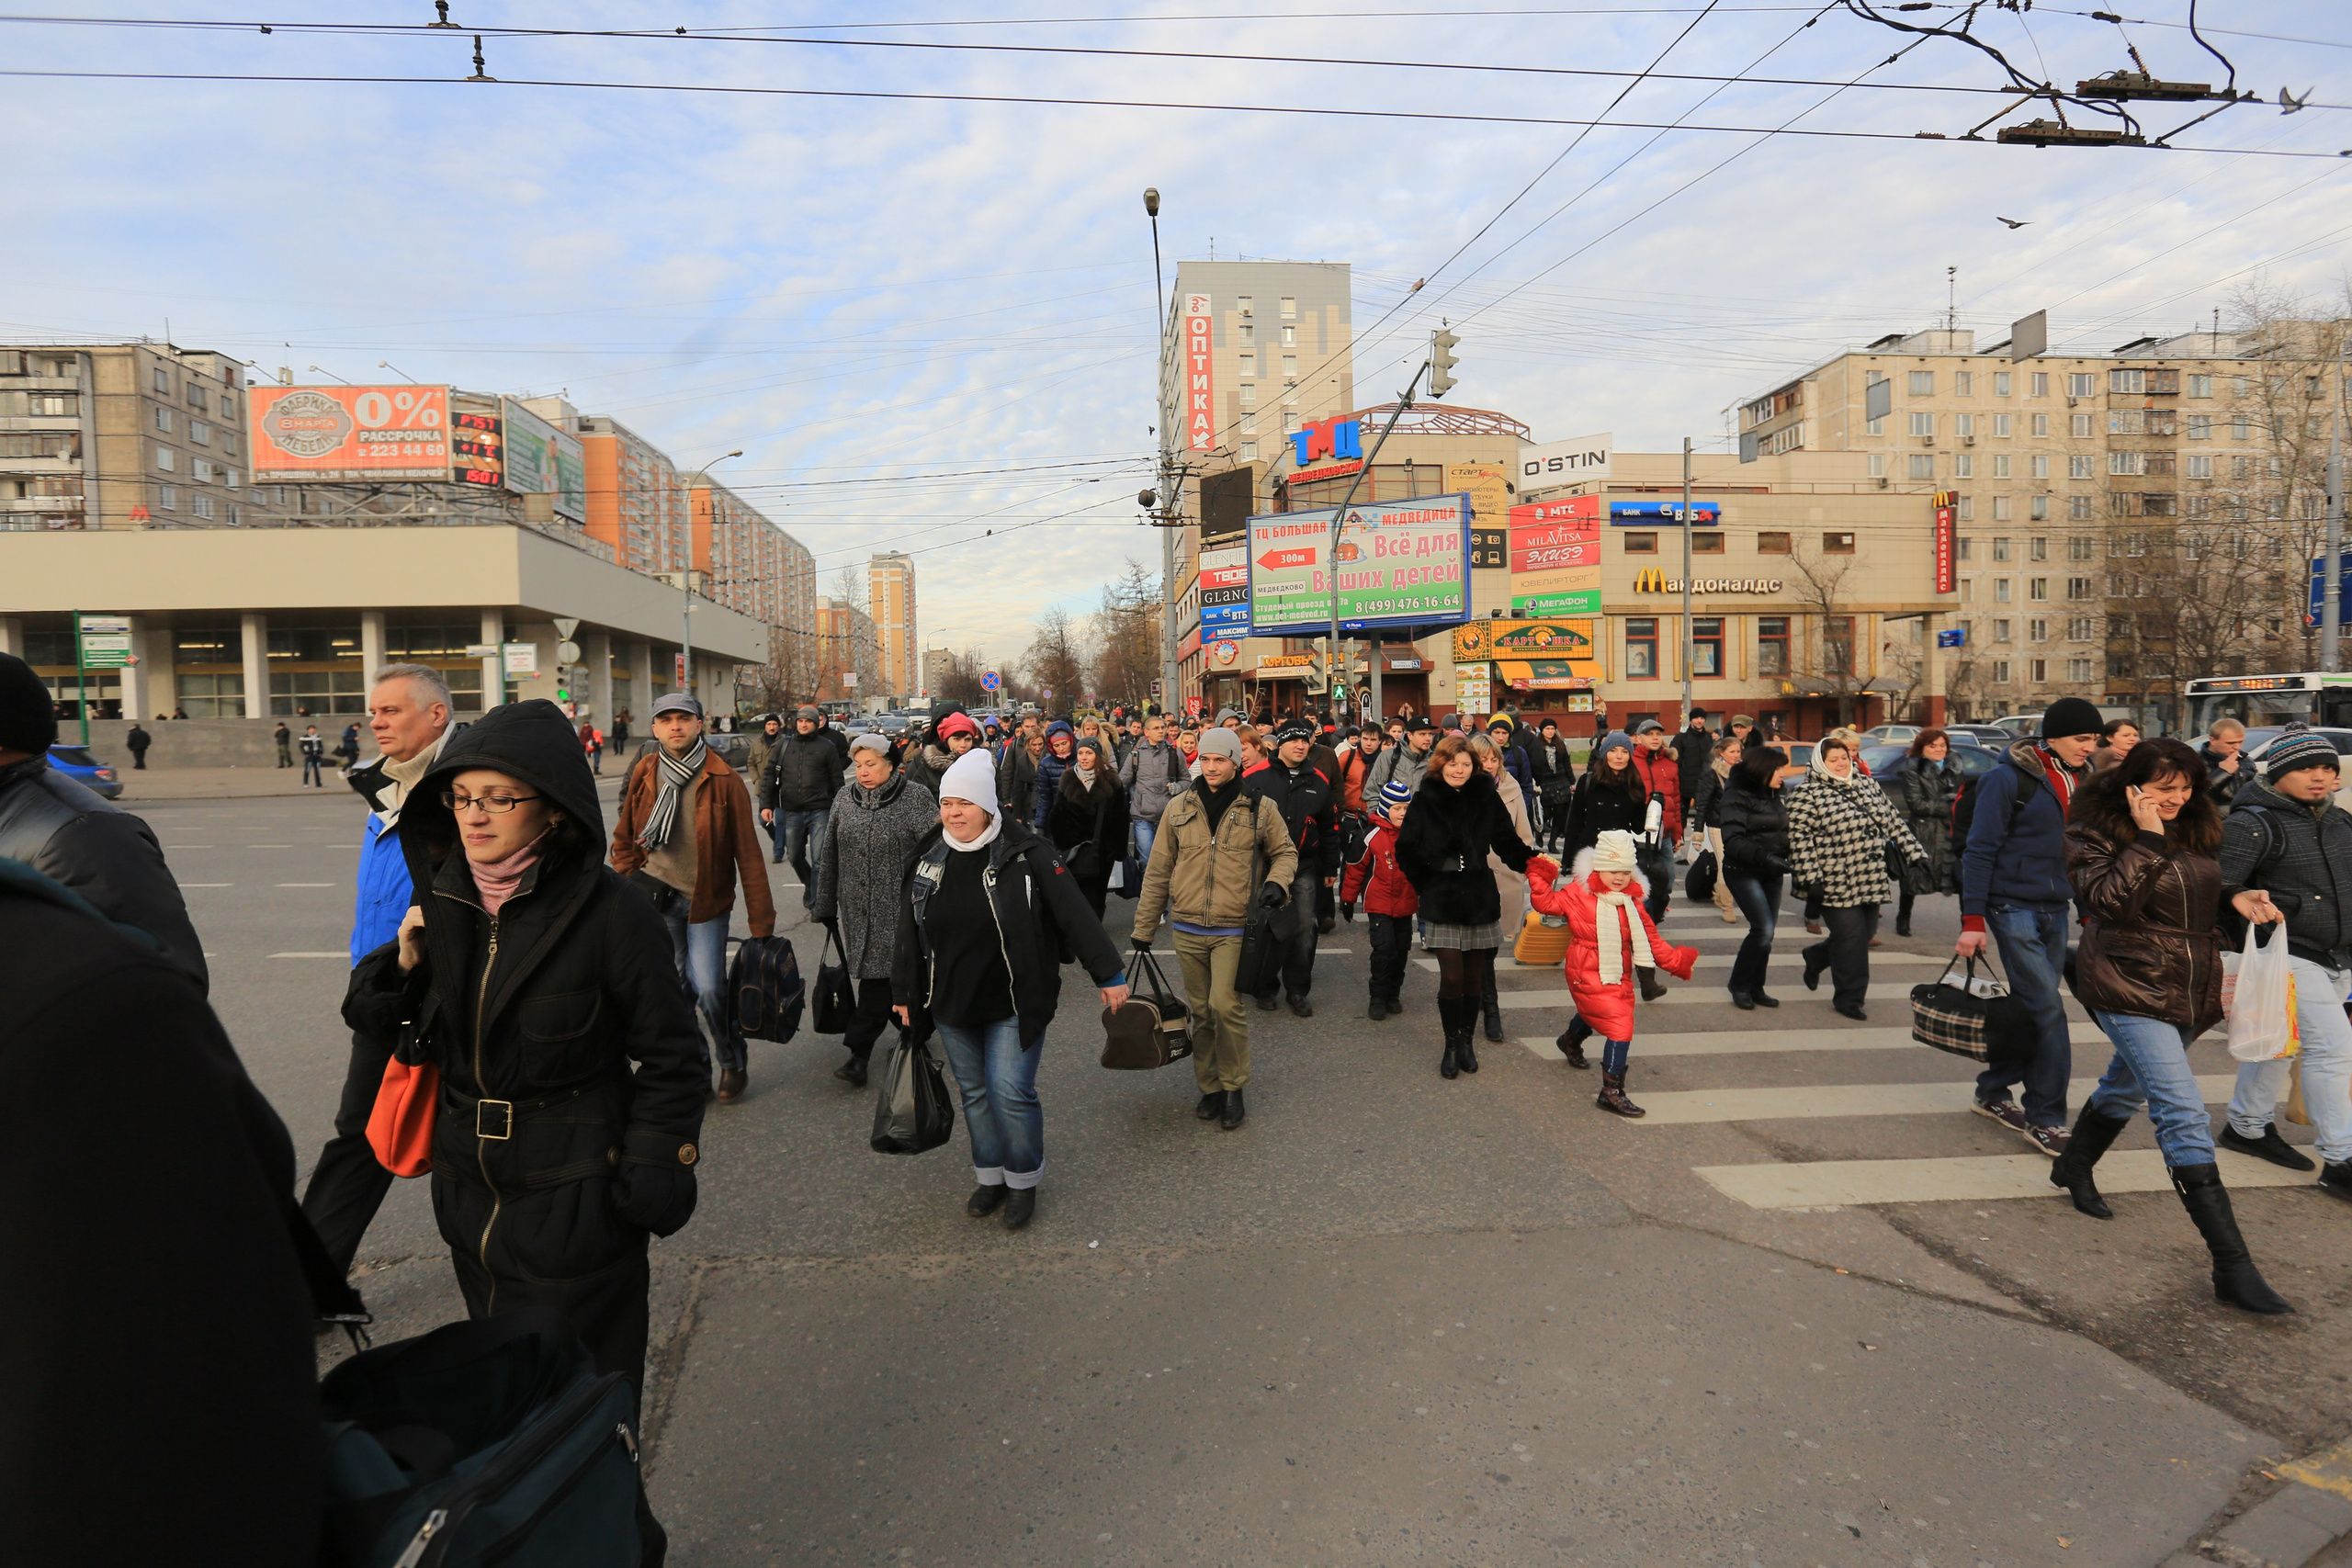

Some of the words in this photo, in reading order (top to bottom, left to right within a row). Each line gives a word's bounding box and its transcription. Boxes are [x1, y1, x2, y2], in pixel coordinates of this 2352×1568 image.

[1192, 318, 1209, 430] ОПТИКА
[280, 396, 334, 416] ФАБРИКА
[282, 420, 294, 429] 8
[294, 419, 334, 428] МАРТА
[359, 430, 441, 442] РАССРОЧКА
[1289, 414, 1363, 466] ТМЦ
[282, 434, 334, 452] МЕБЕЛИ
[369, 445, 400, 457] 223
[402, 445, 423, 457] 44
[425, 445, 446, 456] 60
[1288, 459, 1364, 484] МЕДВЕДКОВСКИЙ
[1382, 507, 1456, 526] МЕДВЕДИЦА
[1550, 504, 1575, 516] МТС
[1623, 508, 1641, 516] БАНК
[1675, 509, 1713, 522] ВБ24
[1256, 528, 1270, 540] ТЦ
[1272, 521, 1327, 538] БОЛЬШАЯ
[1374, 532, 1411, 558] Всё
[1416, 534, 1459, 558] для
[1527, 530, 1581, 547] MILAVITSA
[1281, 553, 1306, 564] 300м
[1213, 570, 1248, 582] ТВОЕ
[1392, 558, 1459, 591] детей
[1257, 583, 1305, 593] МЕДВЕДКОВО
[1521, 575, 1589, 588] ЮВЕЛИРТОРГ
[1296, 600, 1325, 609] проезд
[1355, 602, 1363, 613] 8
[1364, 598, 1396, 614] (499)
[1397, 593, 1460, 610] 476-16-64
[1232, 611, 1248, 620] ВТБ
[1255, 609, 1329, 622] www.det-medved.ru
[1216, 626, 1249, 636] МАКСИМ
